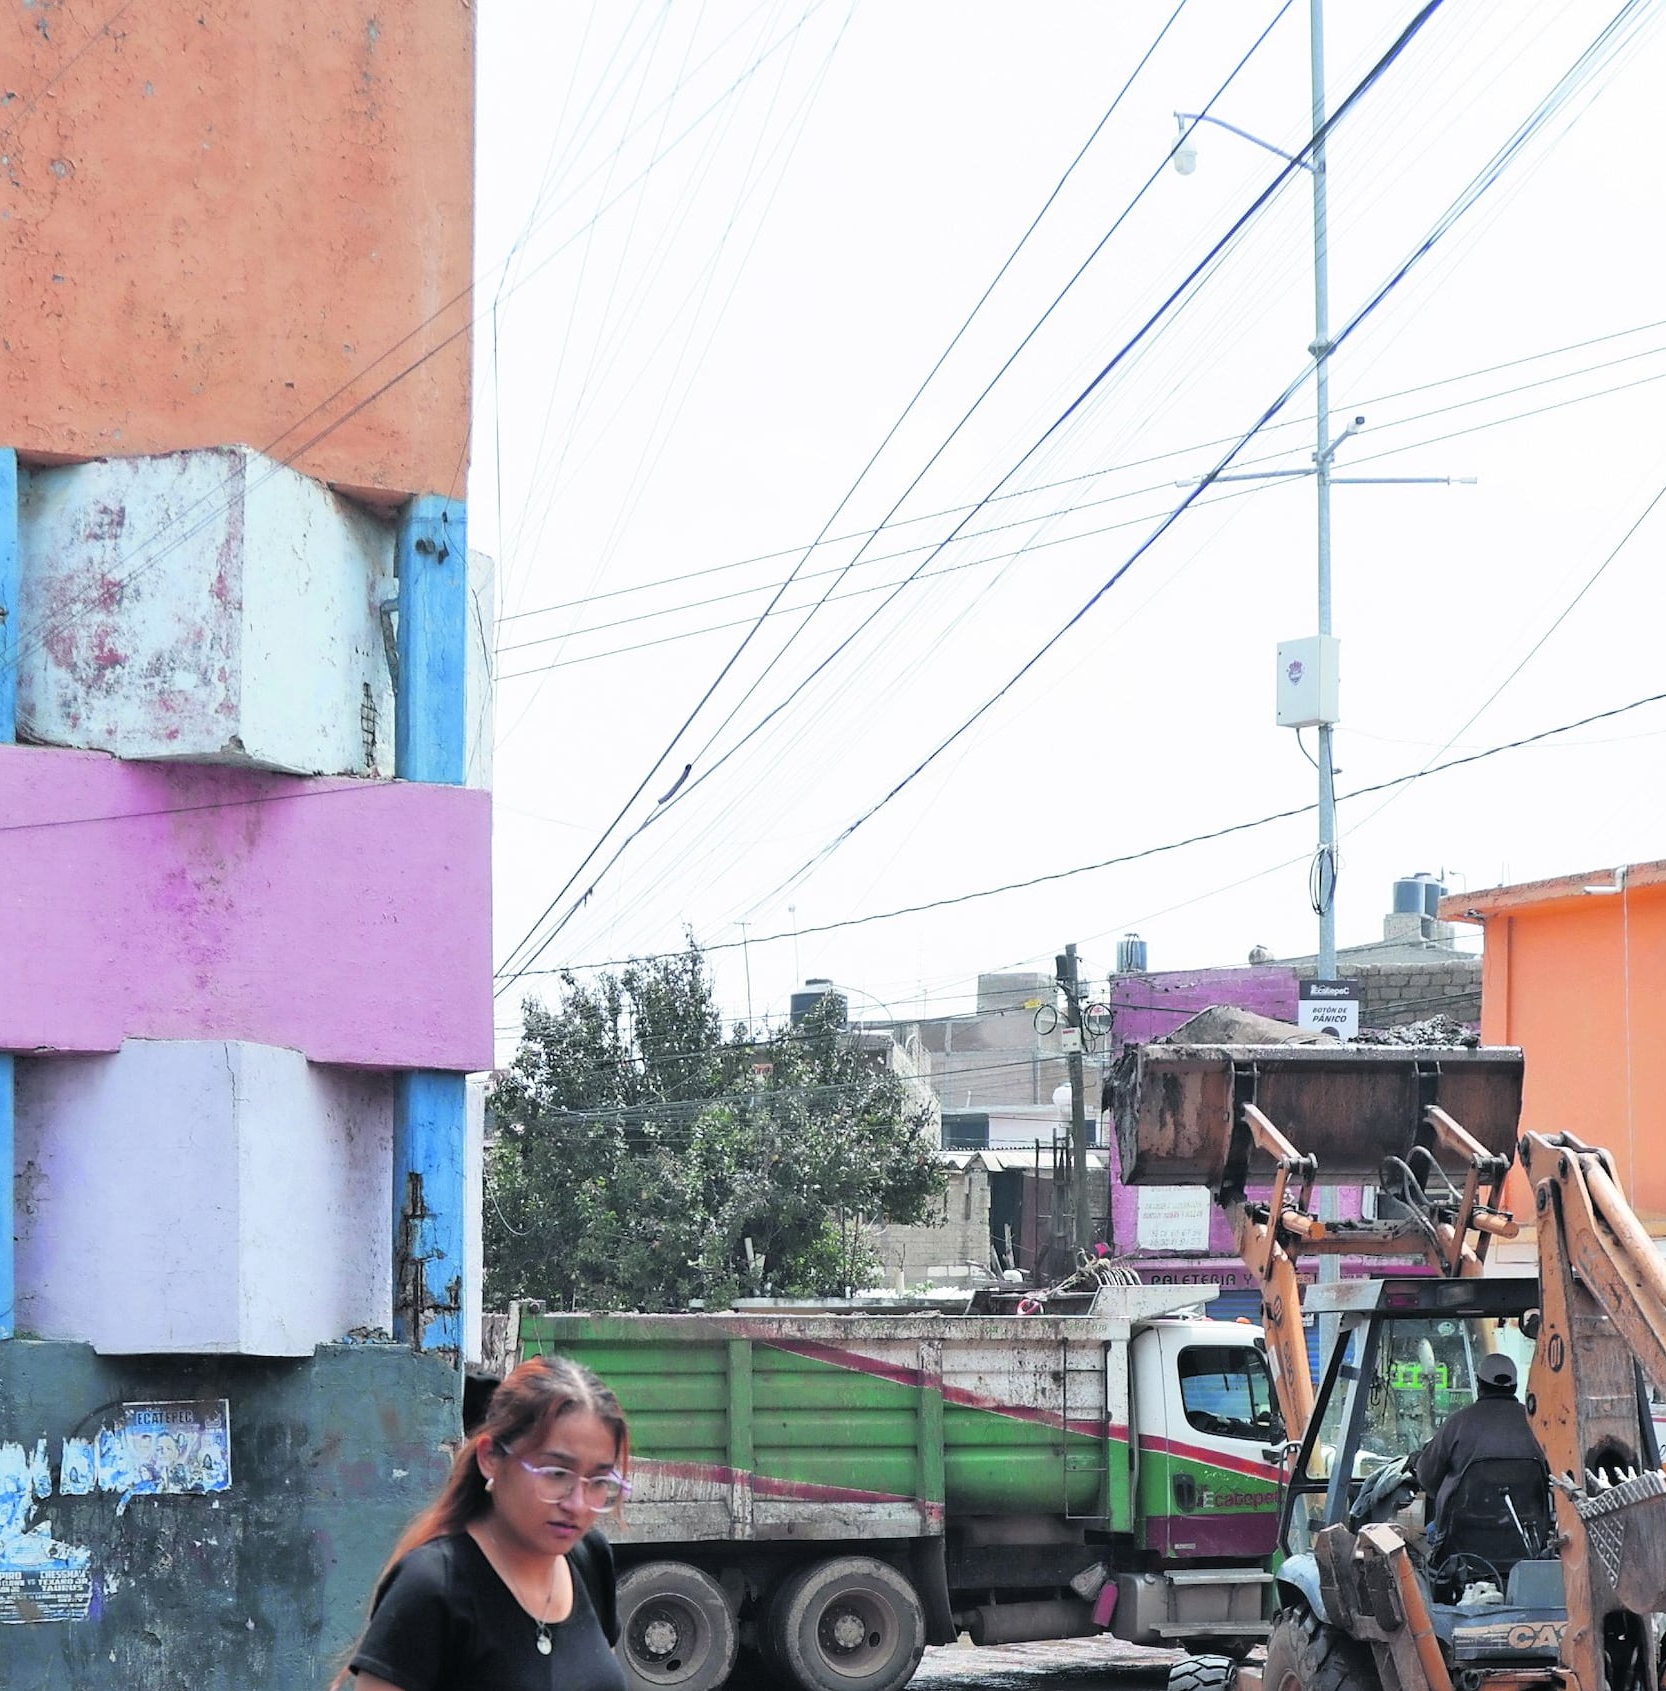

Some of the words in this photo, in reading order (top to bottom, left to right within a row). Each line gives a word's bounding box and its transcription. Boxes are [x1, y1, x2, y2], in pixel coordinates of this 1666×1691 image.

[1312, 1005, 1336, 1014] BOTÓN
[1312, 1013, 1347, 1023] PÁNICO
[1243, 1273, 1253, 1285] Y
[136, 1411, 194, 1425] ECATEPEC
